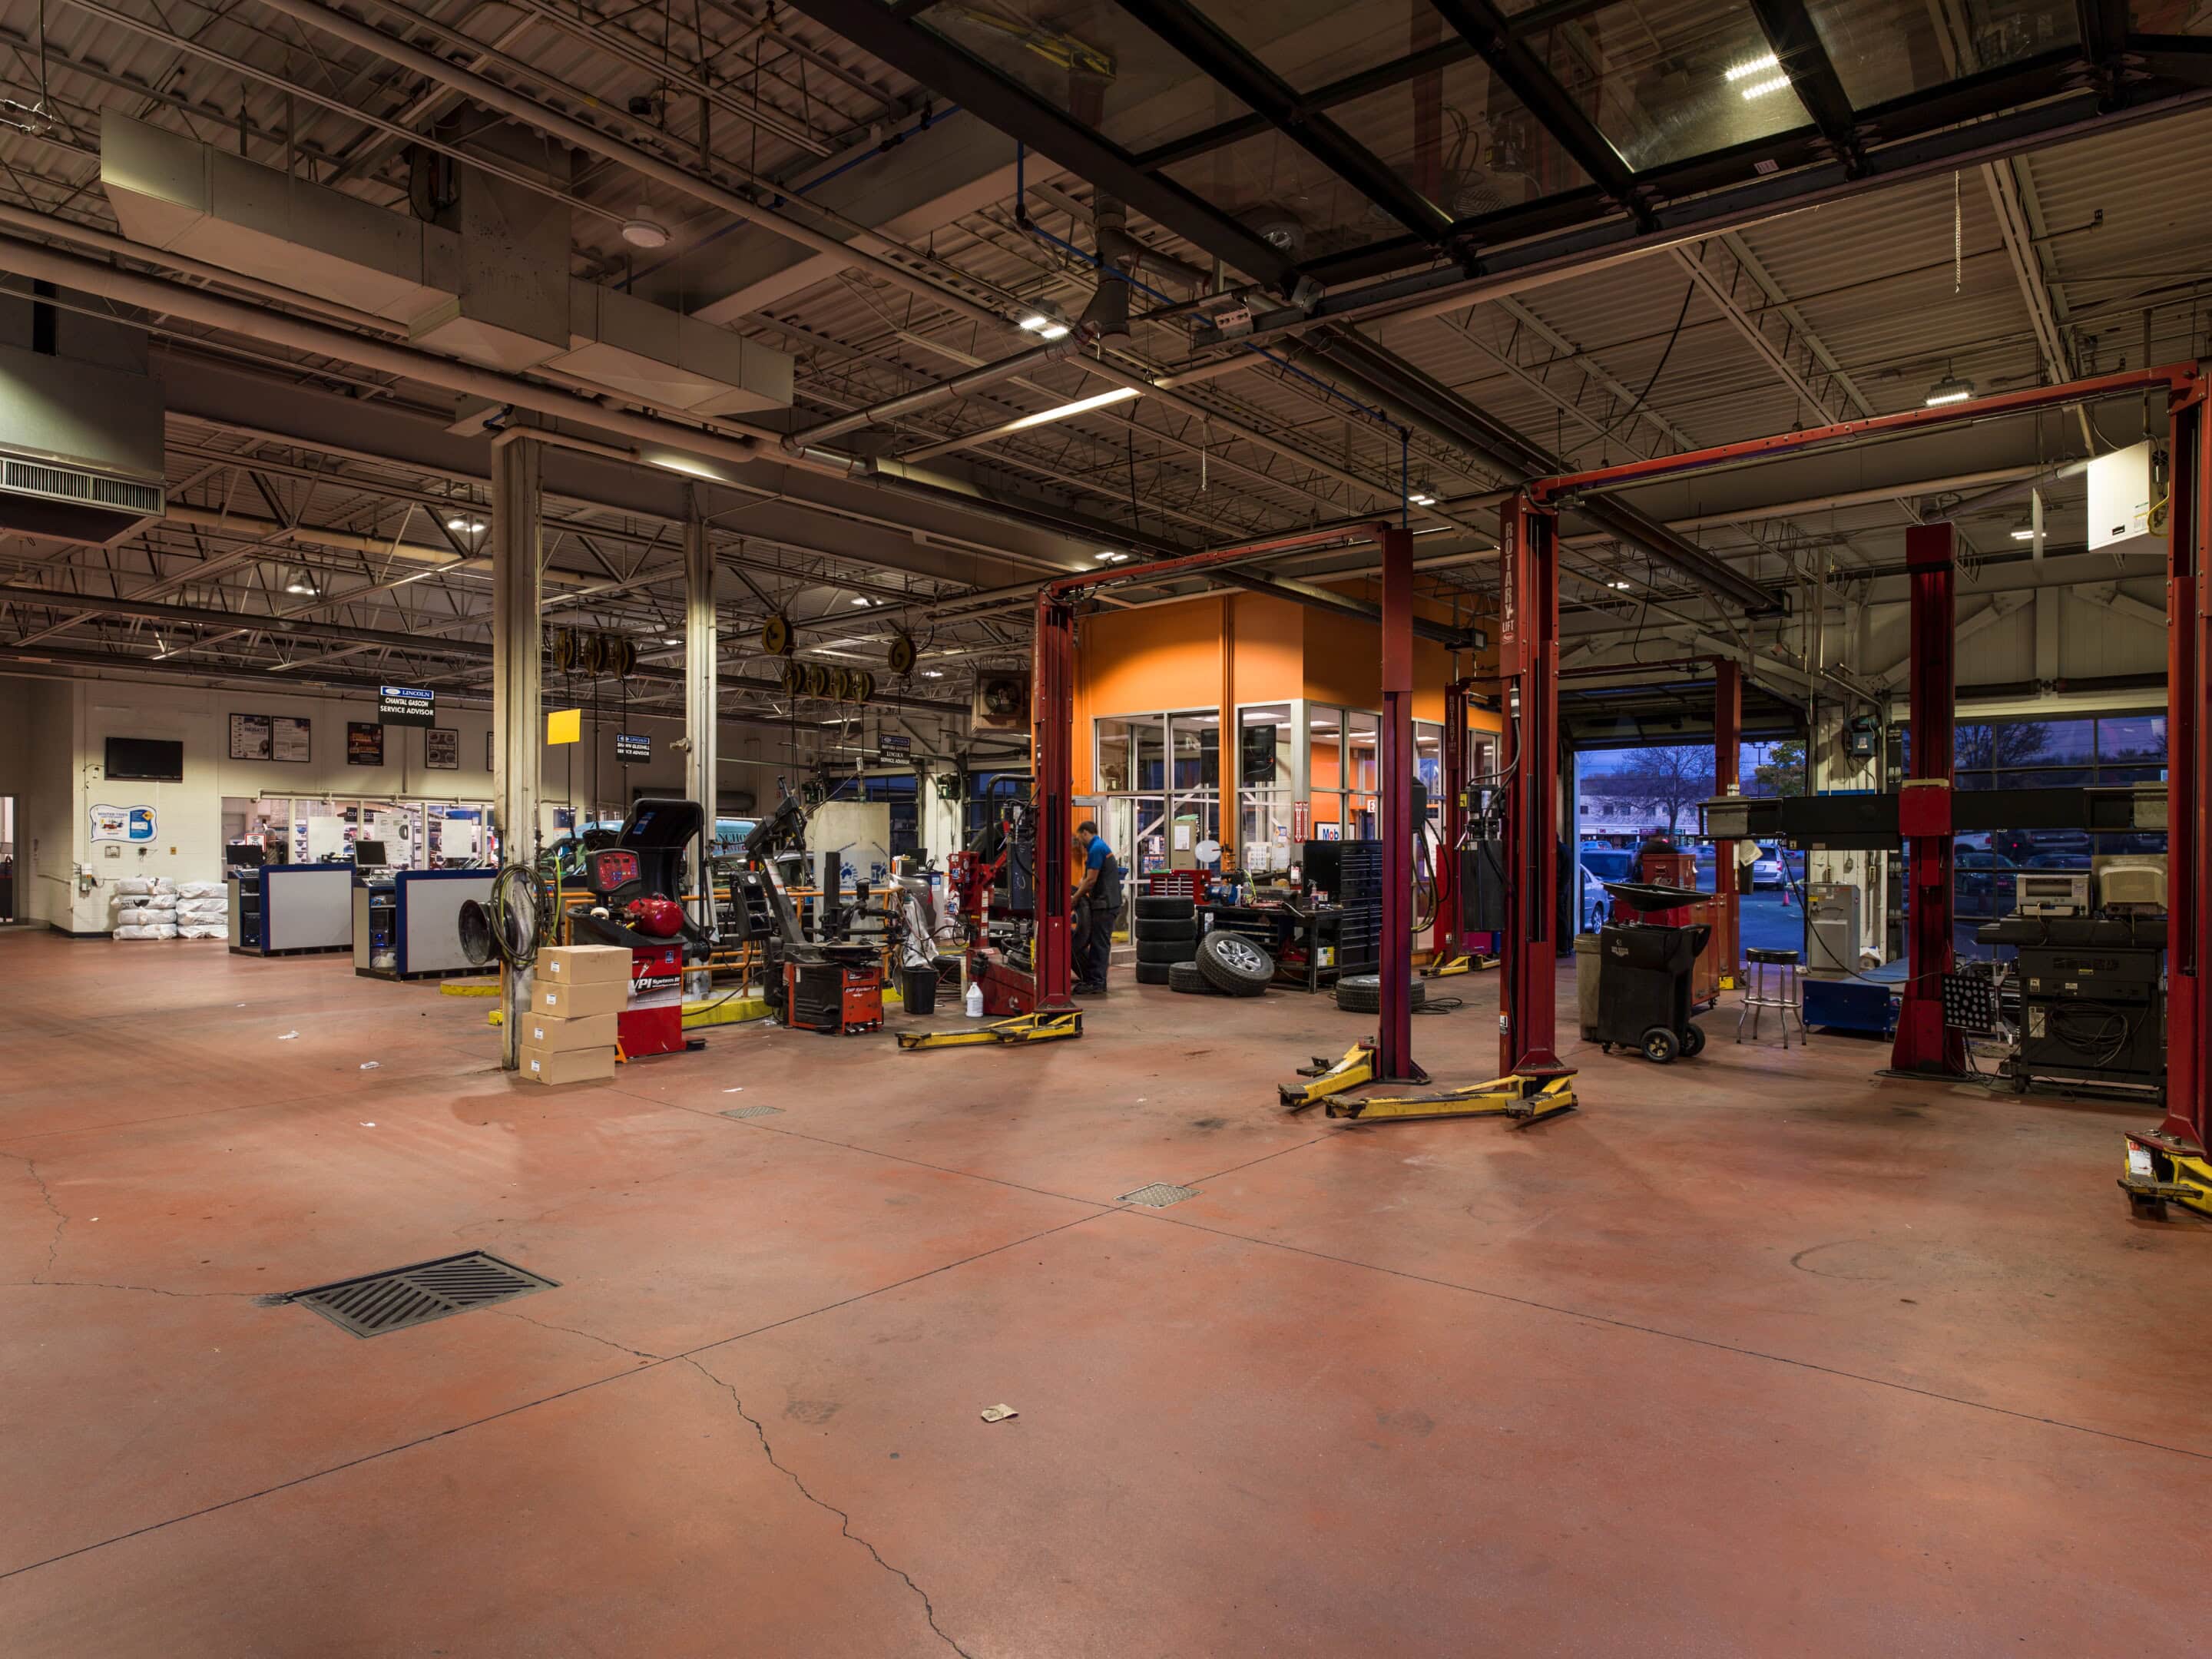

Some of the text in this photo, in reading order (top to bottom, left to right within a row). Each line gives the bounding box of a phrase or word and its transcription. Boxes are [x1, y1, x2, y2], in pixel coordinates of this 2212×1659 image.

[1505, 522, 1513, 619] ROTARY
[1502, 621, 1515, 633] LIFT
[385, 697, 407, 706] CHANTAL
[380, 705, 406, 714] SERVICE
